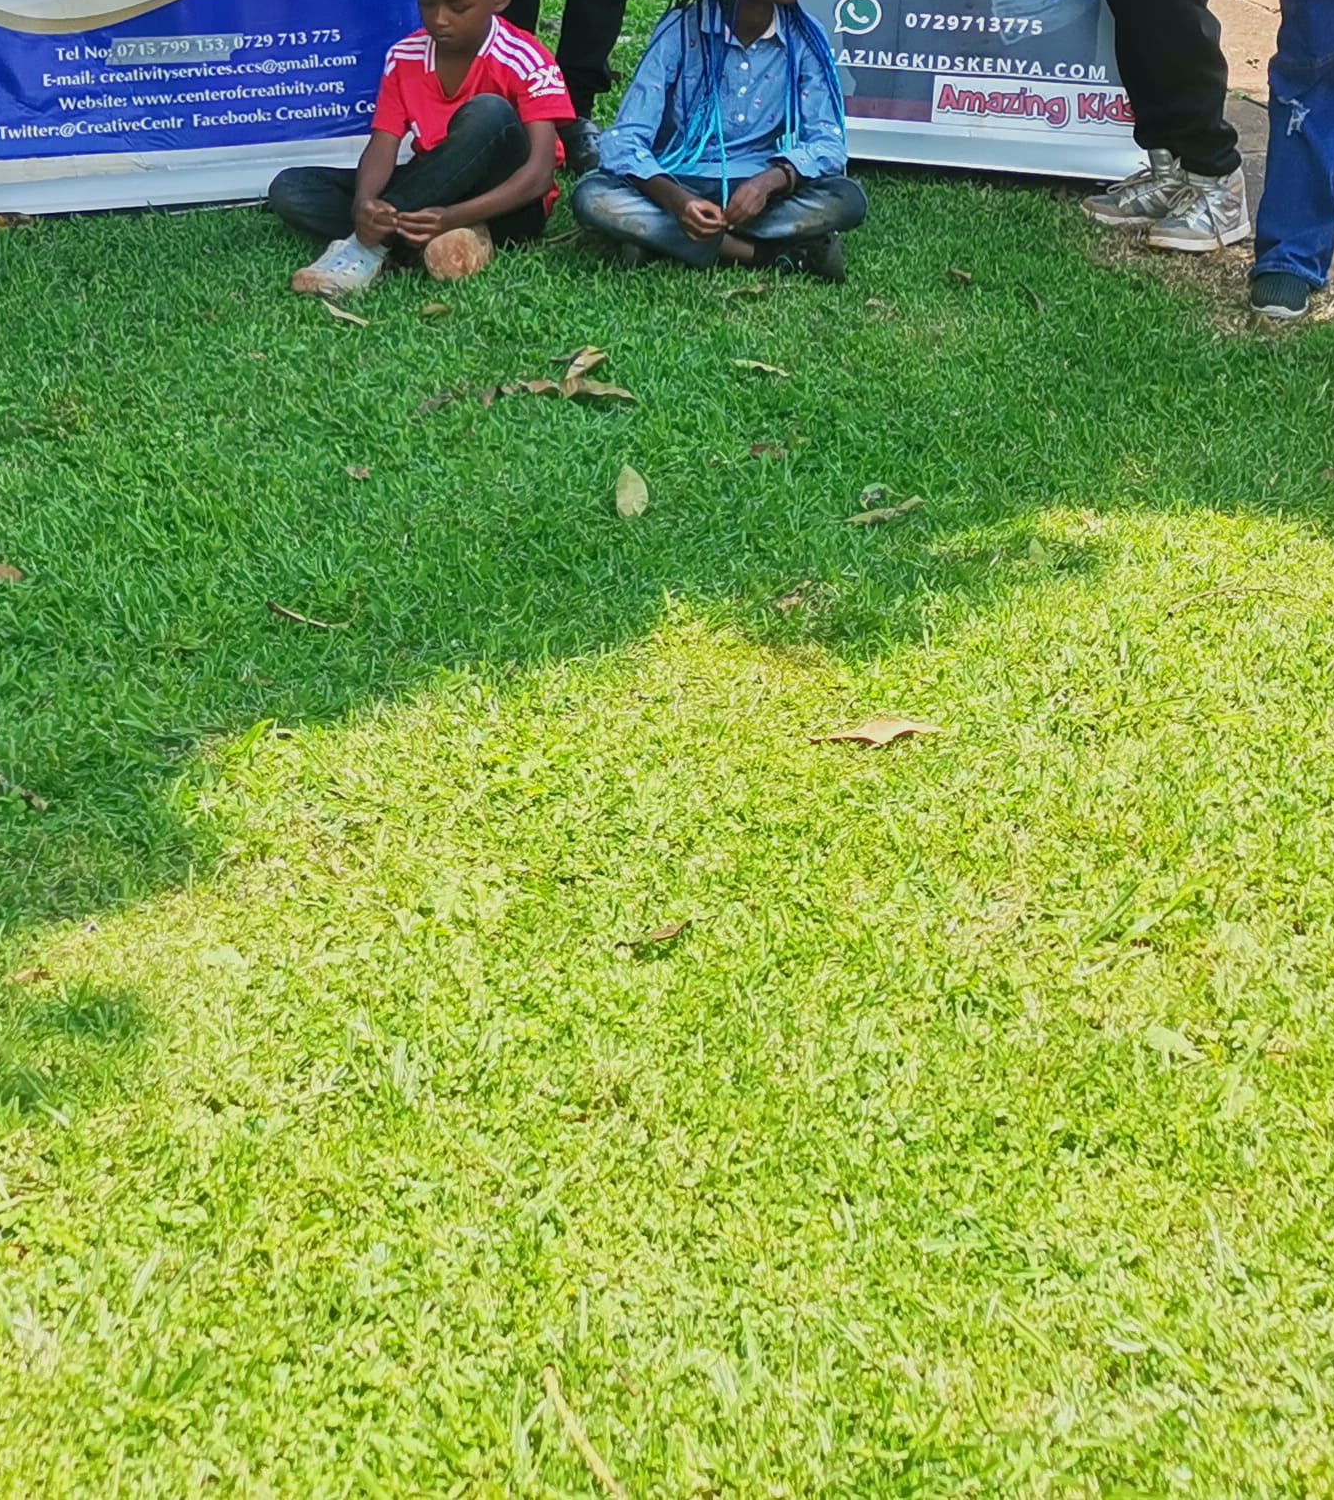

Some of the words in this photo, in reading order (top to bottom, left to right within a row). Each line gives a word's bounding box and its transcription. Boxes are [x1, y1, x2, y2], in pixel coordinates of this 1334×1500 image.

[906, 13, 1043, 36] 0729713775
[55, 46, 79, 61] Tel
[84, 45, 113, 60] No:
[117, 43, 156, 58] 0715
[161, 40, 190, 55] 799
[234, 34, 273, 50] 0729
[278, 31, 307, 46] 713
[312, 29, 340, 43] 775
[42, 71, 95, 87] E-mail:
[100, 54, 357, 82] creativityservices.ccs@gmail.com
[833, 47, 1107, 80] AZINGKIDSKENYA.COM
[58, 94, 127, 111] Website:
[131, 80, 345, 106] www.centerofcreativity.org
[937, 84, 1067, 127] Amazing
[193, 108, 271, 128] Facebook:
[276, 102, 350, 121] Creativity
